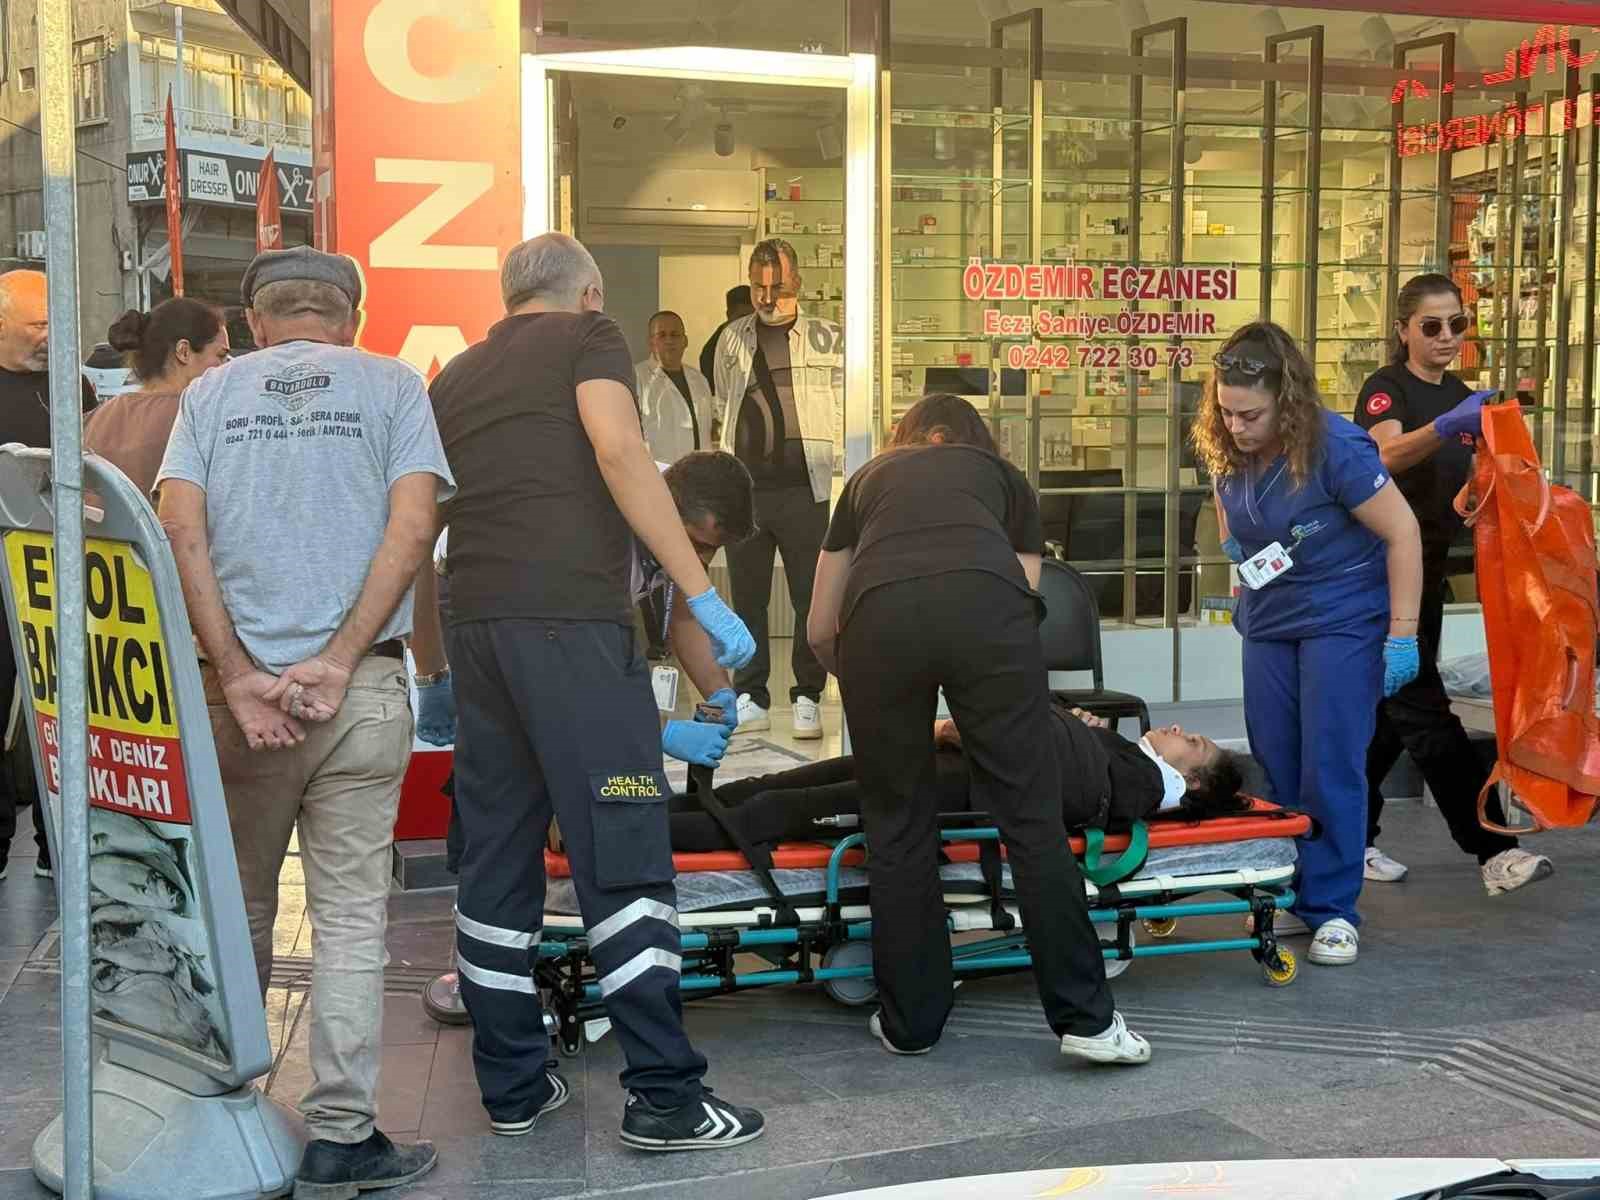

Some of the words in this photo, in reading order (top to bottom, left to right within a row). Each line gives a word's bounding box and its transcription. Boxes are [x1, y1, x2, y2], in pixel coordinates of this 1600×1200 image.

[128, 162, 150, 184] ONUR
[199, 161, 220, 176] HAIR
[190, 178, 229, 197] DRESSER
[235, 170, 260, 195] ON
[963, 257, 1094, 300] ÖZDEMİR
[1102, 261, 1238, 300] ECZANESİ
[1039, 309, 1111, 339] Saniye
[1117, 307, 1216, 334] ÖZDEMİR
[1008, 345, 1069, 369] 0242
[1077, 345, 1121, 369] 722
[1128, 346, 1158, 369] 30
[1166, 346, 1194, 369] 73
[226, 416, 249, 430] BORU
[255, 413, 284, 426] PROFİL
[310, 411, 332, 423] SERA
[334, 409, 361, 424] DEMİR
[248, 429, 262, 440] 721
[323, 424, 362, 439] ANTALYA
[23, 545, 146, 625] EOL
[22, 620, 172, 726] BAIKCI
[110, 735, 169, 770] DENİZ
[48, 753, 173, 816] BIKLARI
[600, 785, 662, 797] CONTROL
[607, 775, 654, 786] HEALTH
